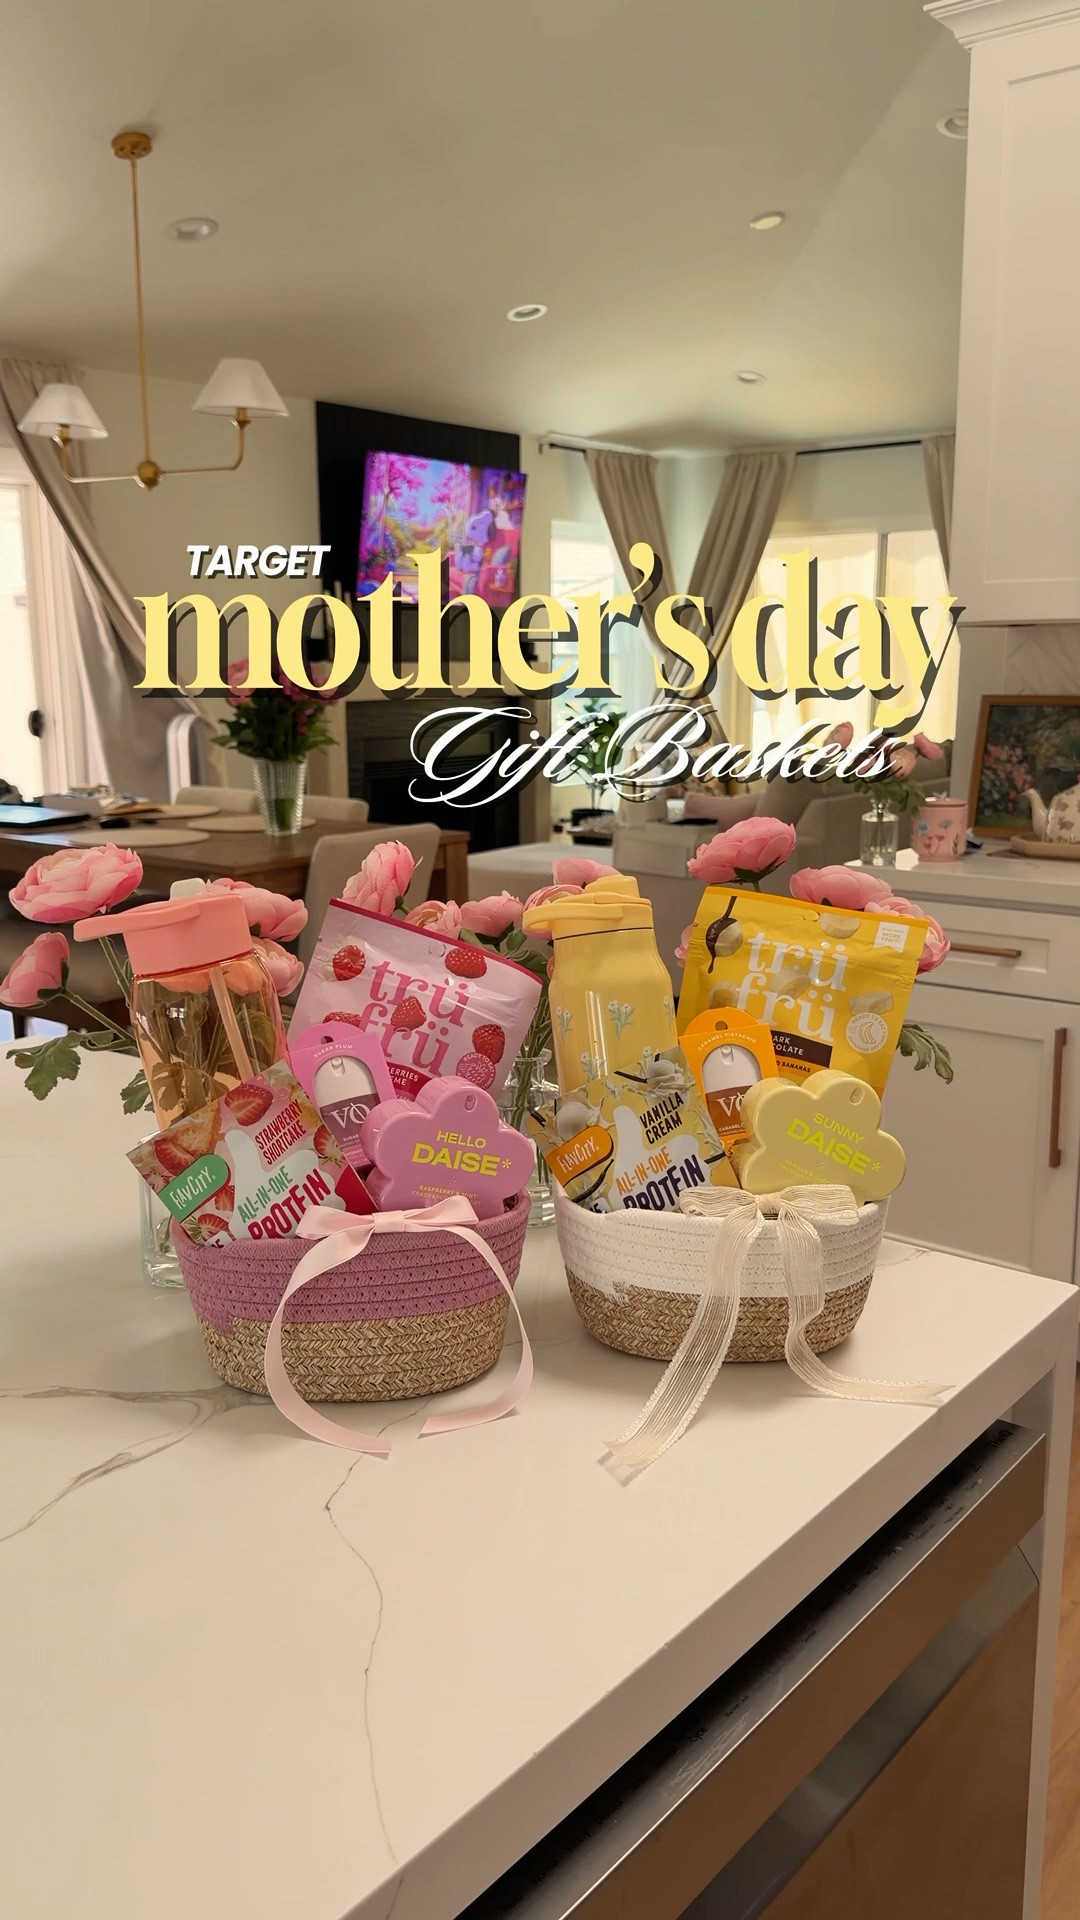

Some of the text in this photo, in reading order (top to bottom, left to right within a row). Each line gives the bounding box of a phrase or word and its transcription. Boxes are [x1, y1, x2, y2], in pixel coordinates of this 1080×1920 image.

[747, 932, 848, 991] trü
[370, 961, 470, 1028] trü
[313, 1045, 334, 1058] SUGAR
[772, 1035, 791, 1044] ARK
[773, 1043, 804, 1056] OLATE
[389, 1067, 419, 1082] ERRIES
[255, 1099, 303, 1151] STRAWBERRY
[639, 1091, 684, 1129] VANILLA
[645, 1111, 683, 1145] CREAM
[813, 1112, 865, 1144] SUNNY
[262, 1119, 307, 1165] SHORTCAKE
[436, 1130, 487, 1149] HELLO
[616, 1146, 673, 1196] ALL-IN-ONE
[236, 1165, 294, 1224] ALL-IN-ONE
